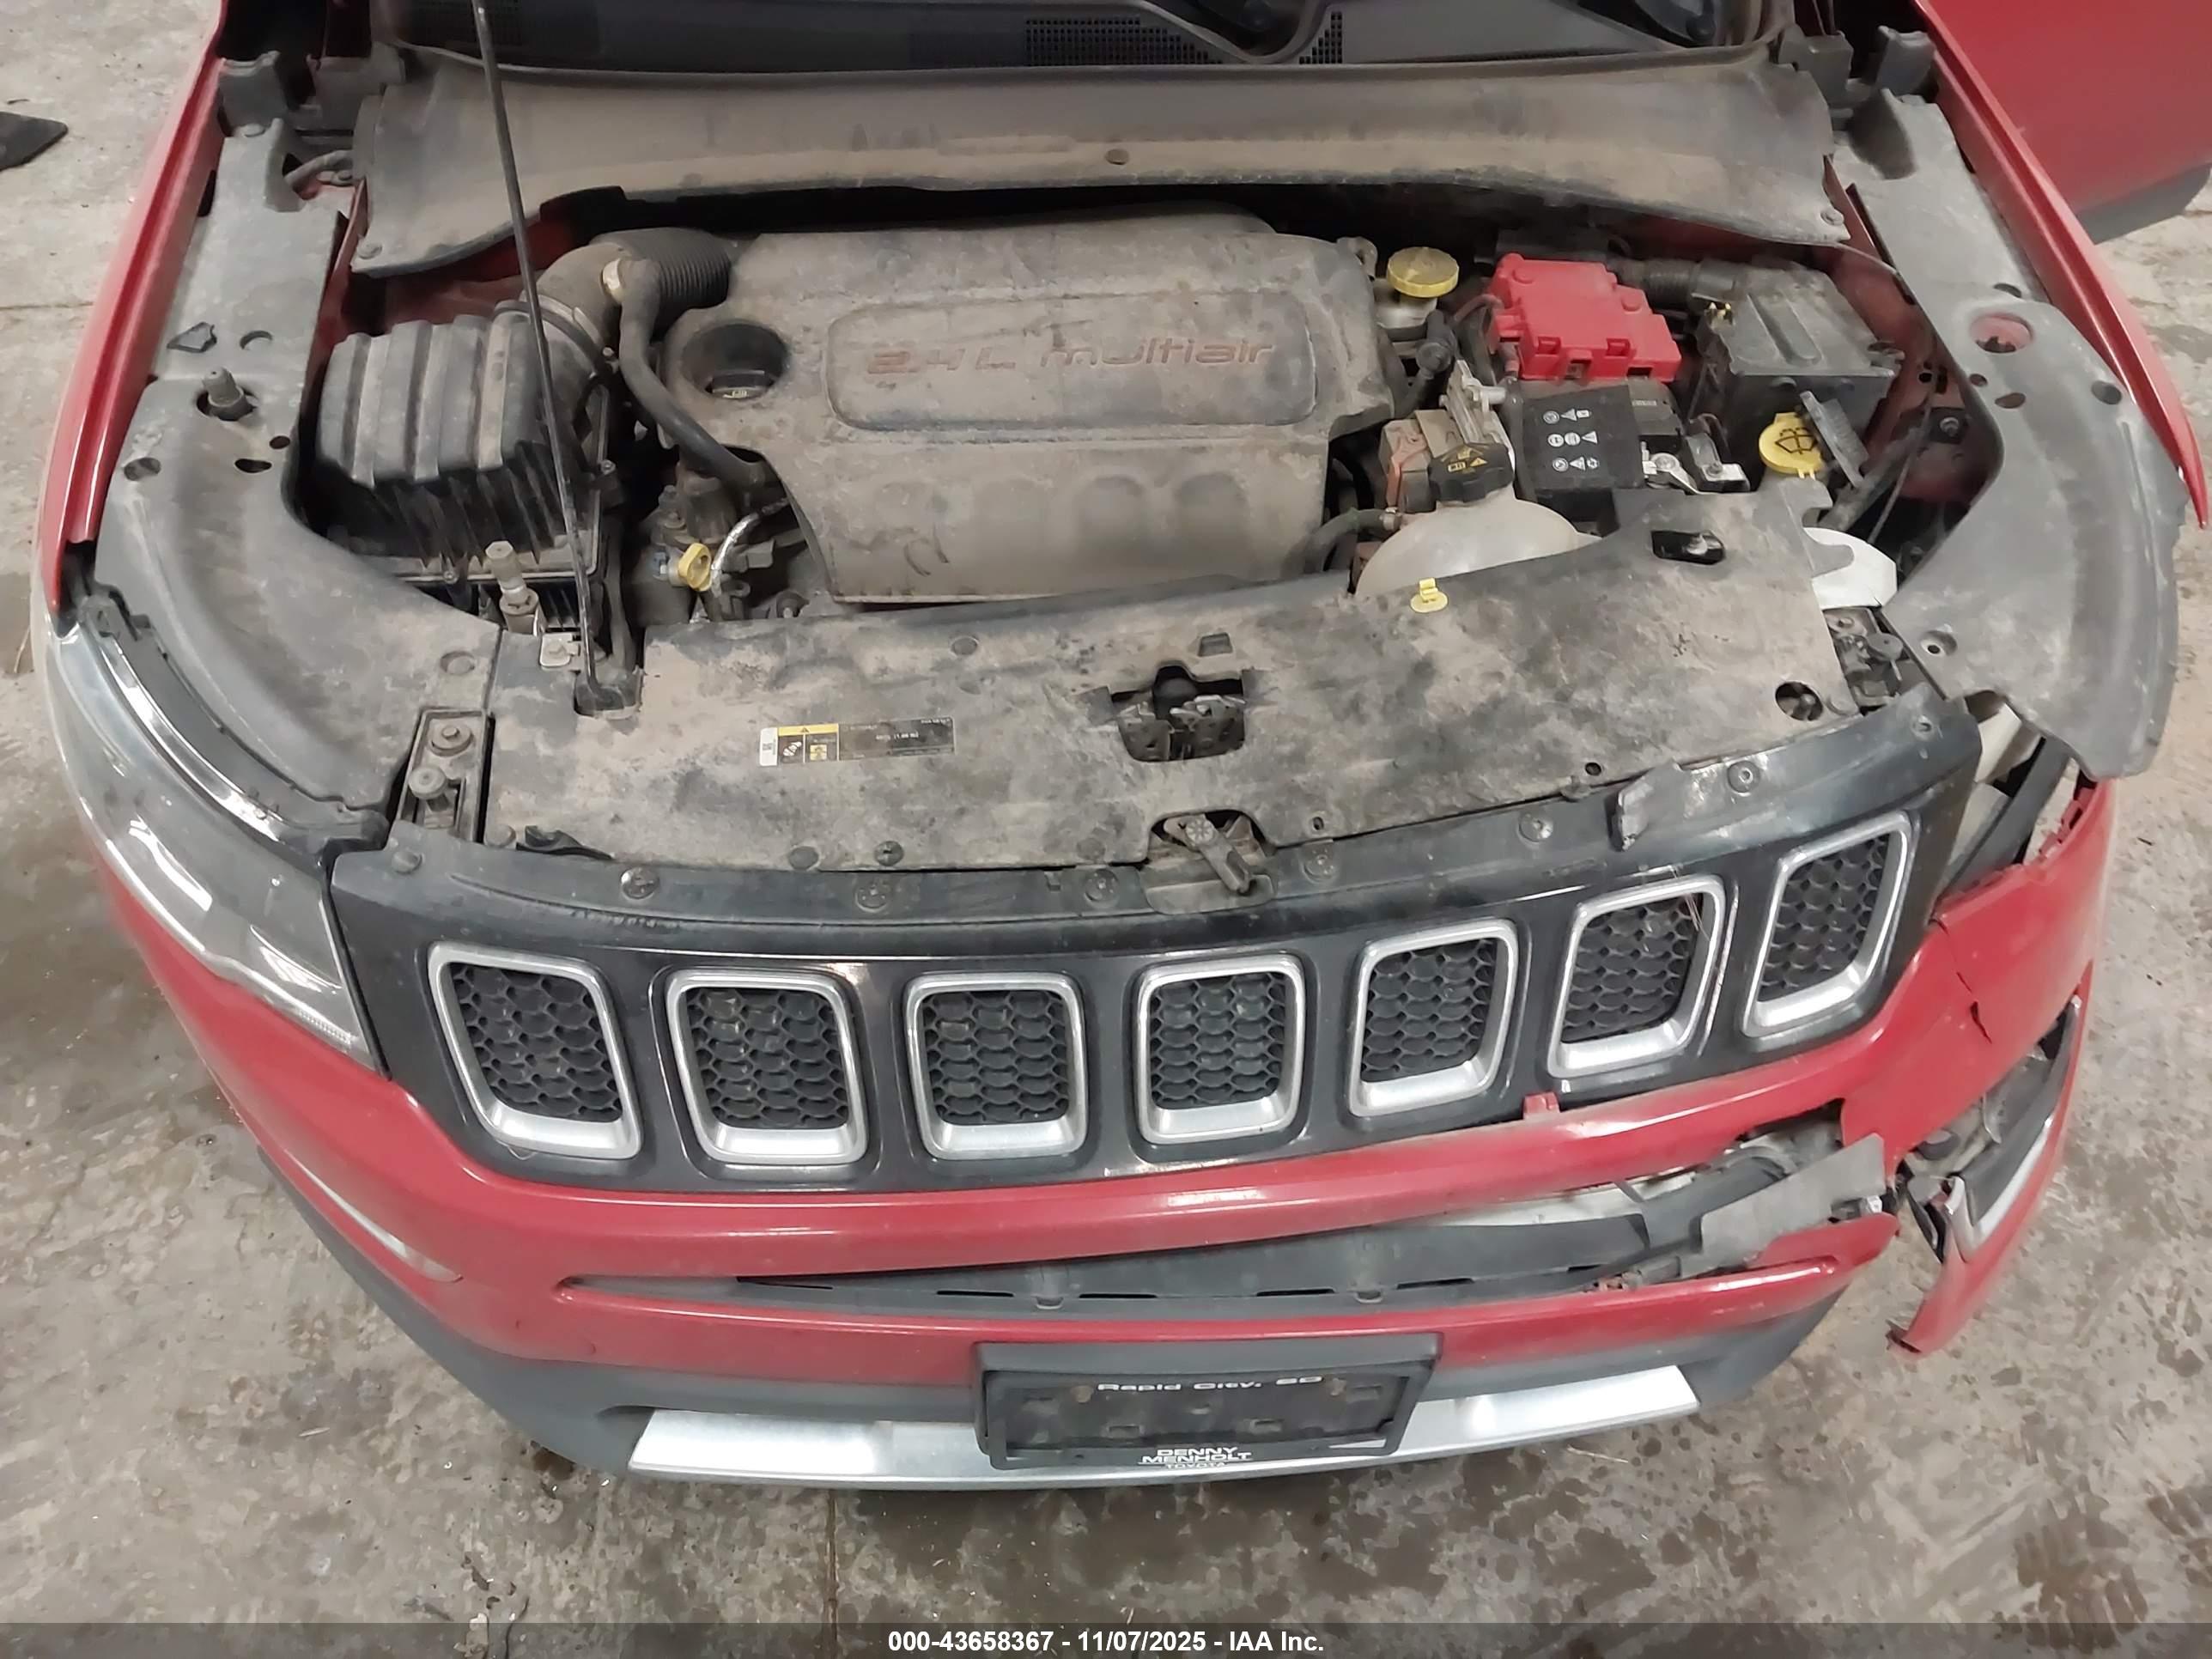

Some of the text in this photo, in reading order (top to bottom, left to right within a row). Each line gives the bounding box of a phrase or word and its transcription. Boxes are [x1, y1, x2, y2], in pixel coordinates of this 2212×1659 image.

[1039, 337, 1273, 368] multiair
[1097, 1382, 1182, 1391] Rapid
[1157, 1447, 1238, 1456] DENNY
[1141, 1452, 1252, 1464] MENHOLT
